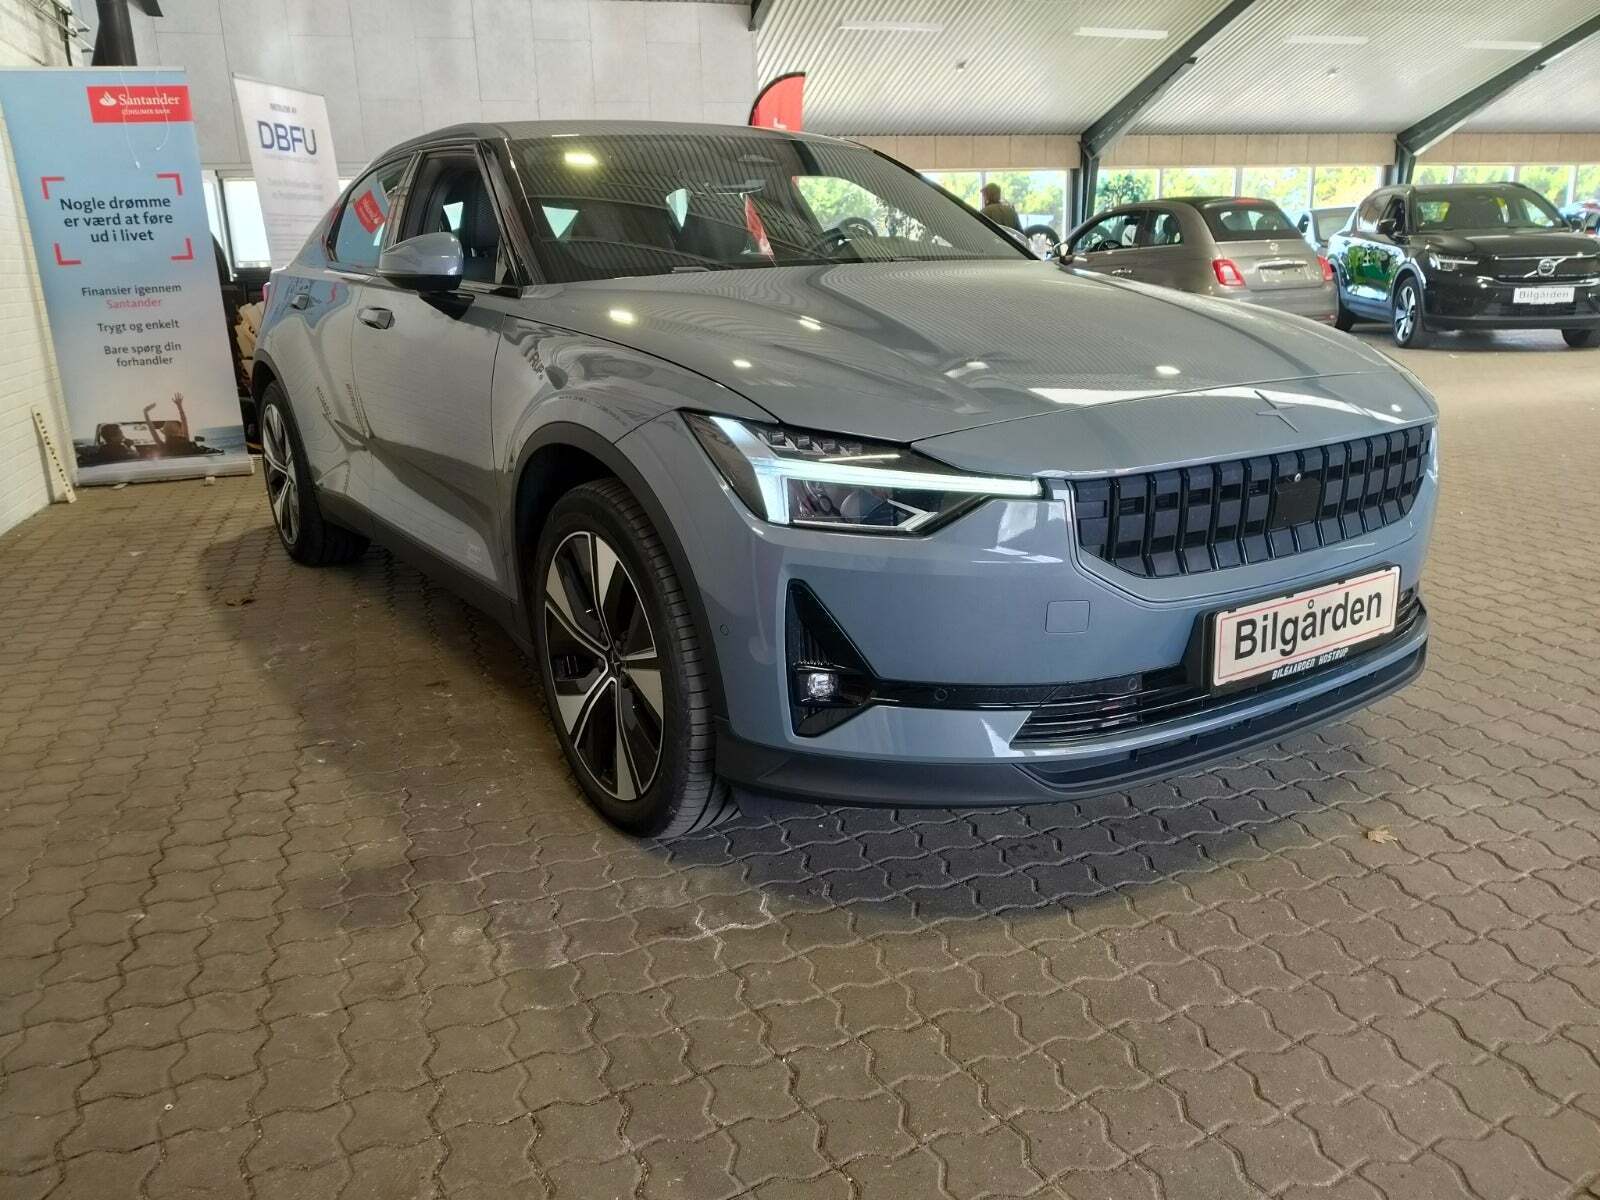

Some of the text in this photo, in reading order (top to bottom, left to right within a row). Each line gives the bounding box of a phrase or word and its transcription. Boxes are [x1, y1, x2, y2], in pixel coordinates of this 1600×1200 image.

[118, 92, 180, 106] Santander
[257, 120, 317, 155] DBFU
[60, 195, 171, 213] Nogle drømme
[64, 211, 173, 227] er værd at føre
[90, 229, 154, 242] ud i livet
[81, 284, 182, 297] Finansier igennem
[106, 298, 162, 309] Santander
[97, 319, 180, 334] Trygt og enkelt
[104, 341, 182, 355] Bare spørg din
[116, 356, 173, 367] forhandler
[1234, 591, 1382, 660] Bilgården
